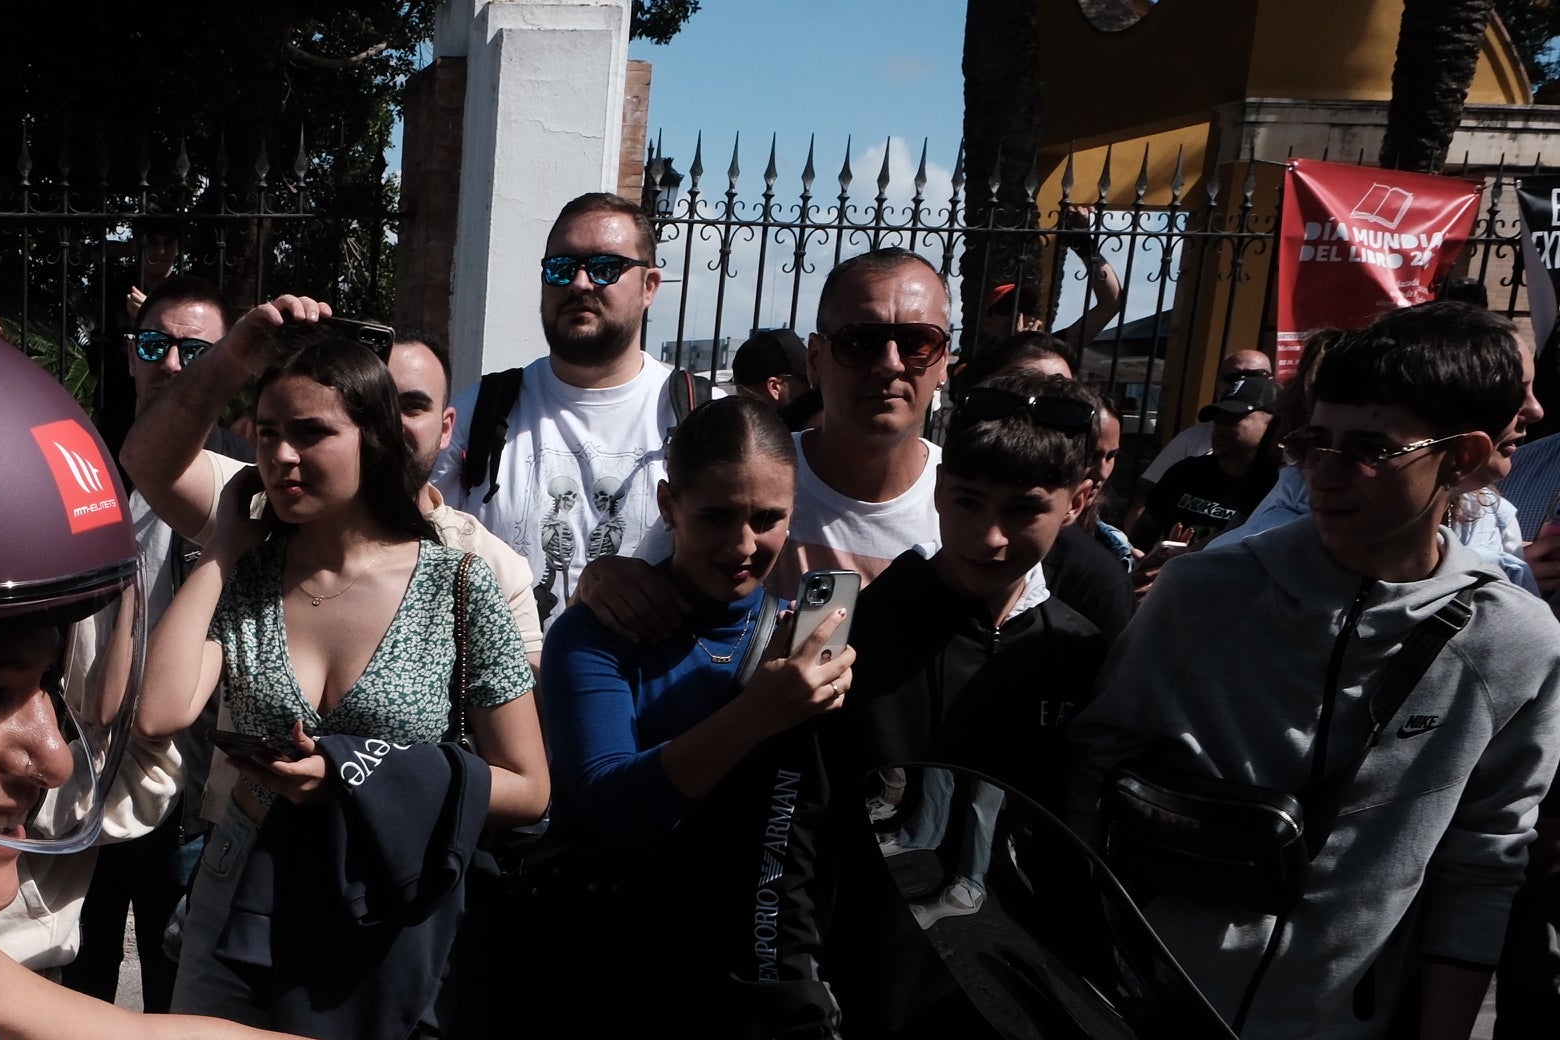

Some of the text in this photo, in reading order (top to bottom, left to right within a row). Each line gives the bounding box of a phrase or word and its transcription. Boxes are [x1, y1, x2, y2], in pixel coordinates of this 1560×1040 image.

[1303, 217, 1444, 250] DÍA MUNDIA
[1299, 244, 1342, 262] DEL
[1349, 246, 1404, 269] LIBRO
[1405, 715, 1439, 728] NIKE
[753, 766, 802, 983] EMPORIO ARMANI
